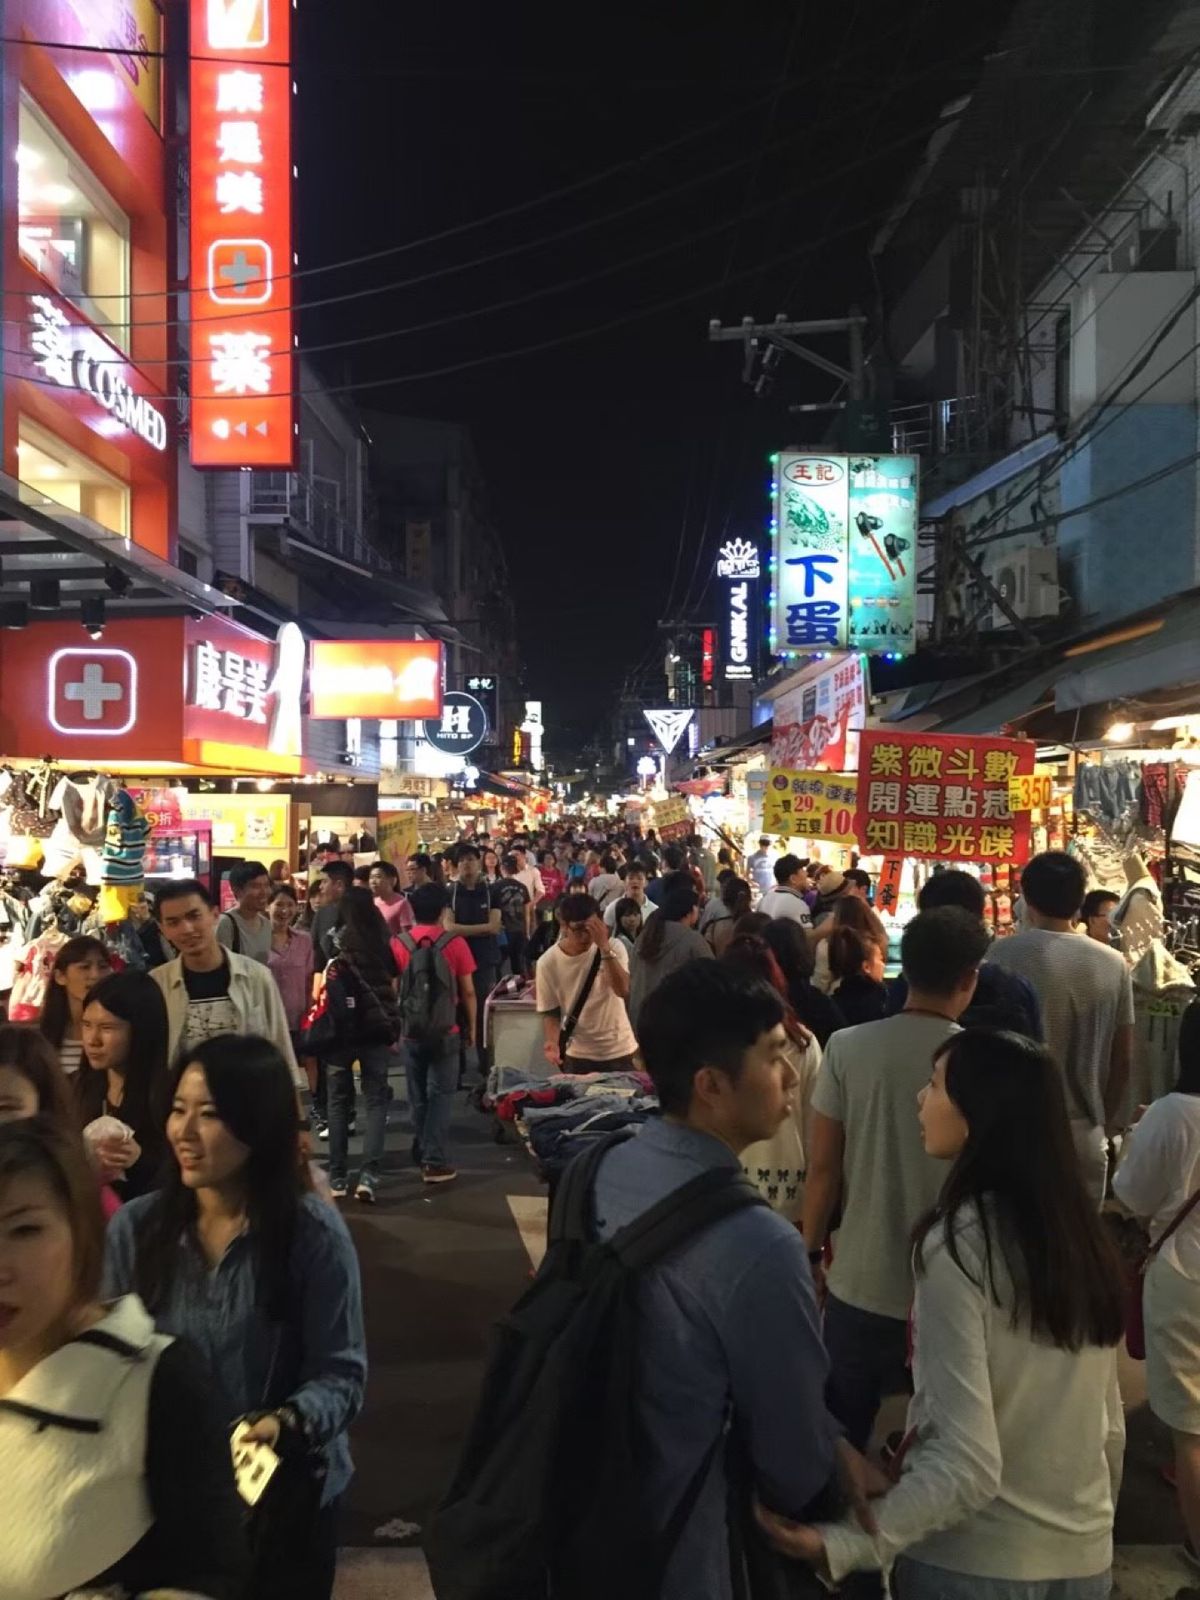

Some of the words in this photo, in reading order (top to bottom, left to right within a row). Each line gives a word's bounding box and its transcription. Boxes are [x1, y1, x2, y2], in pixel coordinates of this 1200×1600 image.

[75, 351, 167, 451] COSMED
[792, 464, 835, 481] 王記
[870, 743, 1020, 784] 紫微斗數
[867, 781, 1014, 820] 開運點痣
[1021, 777, 1051, 808] 350
[866, 818, 1014, 858] 知識光碟
[880, 861, 897, 905] 下蛋
